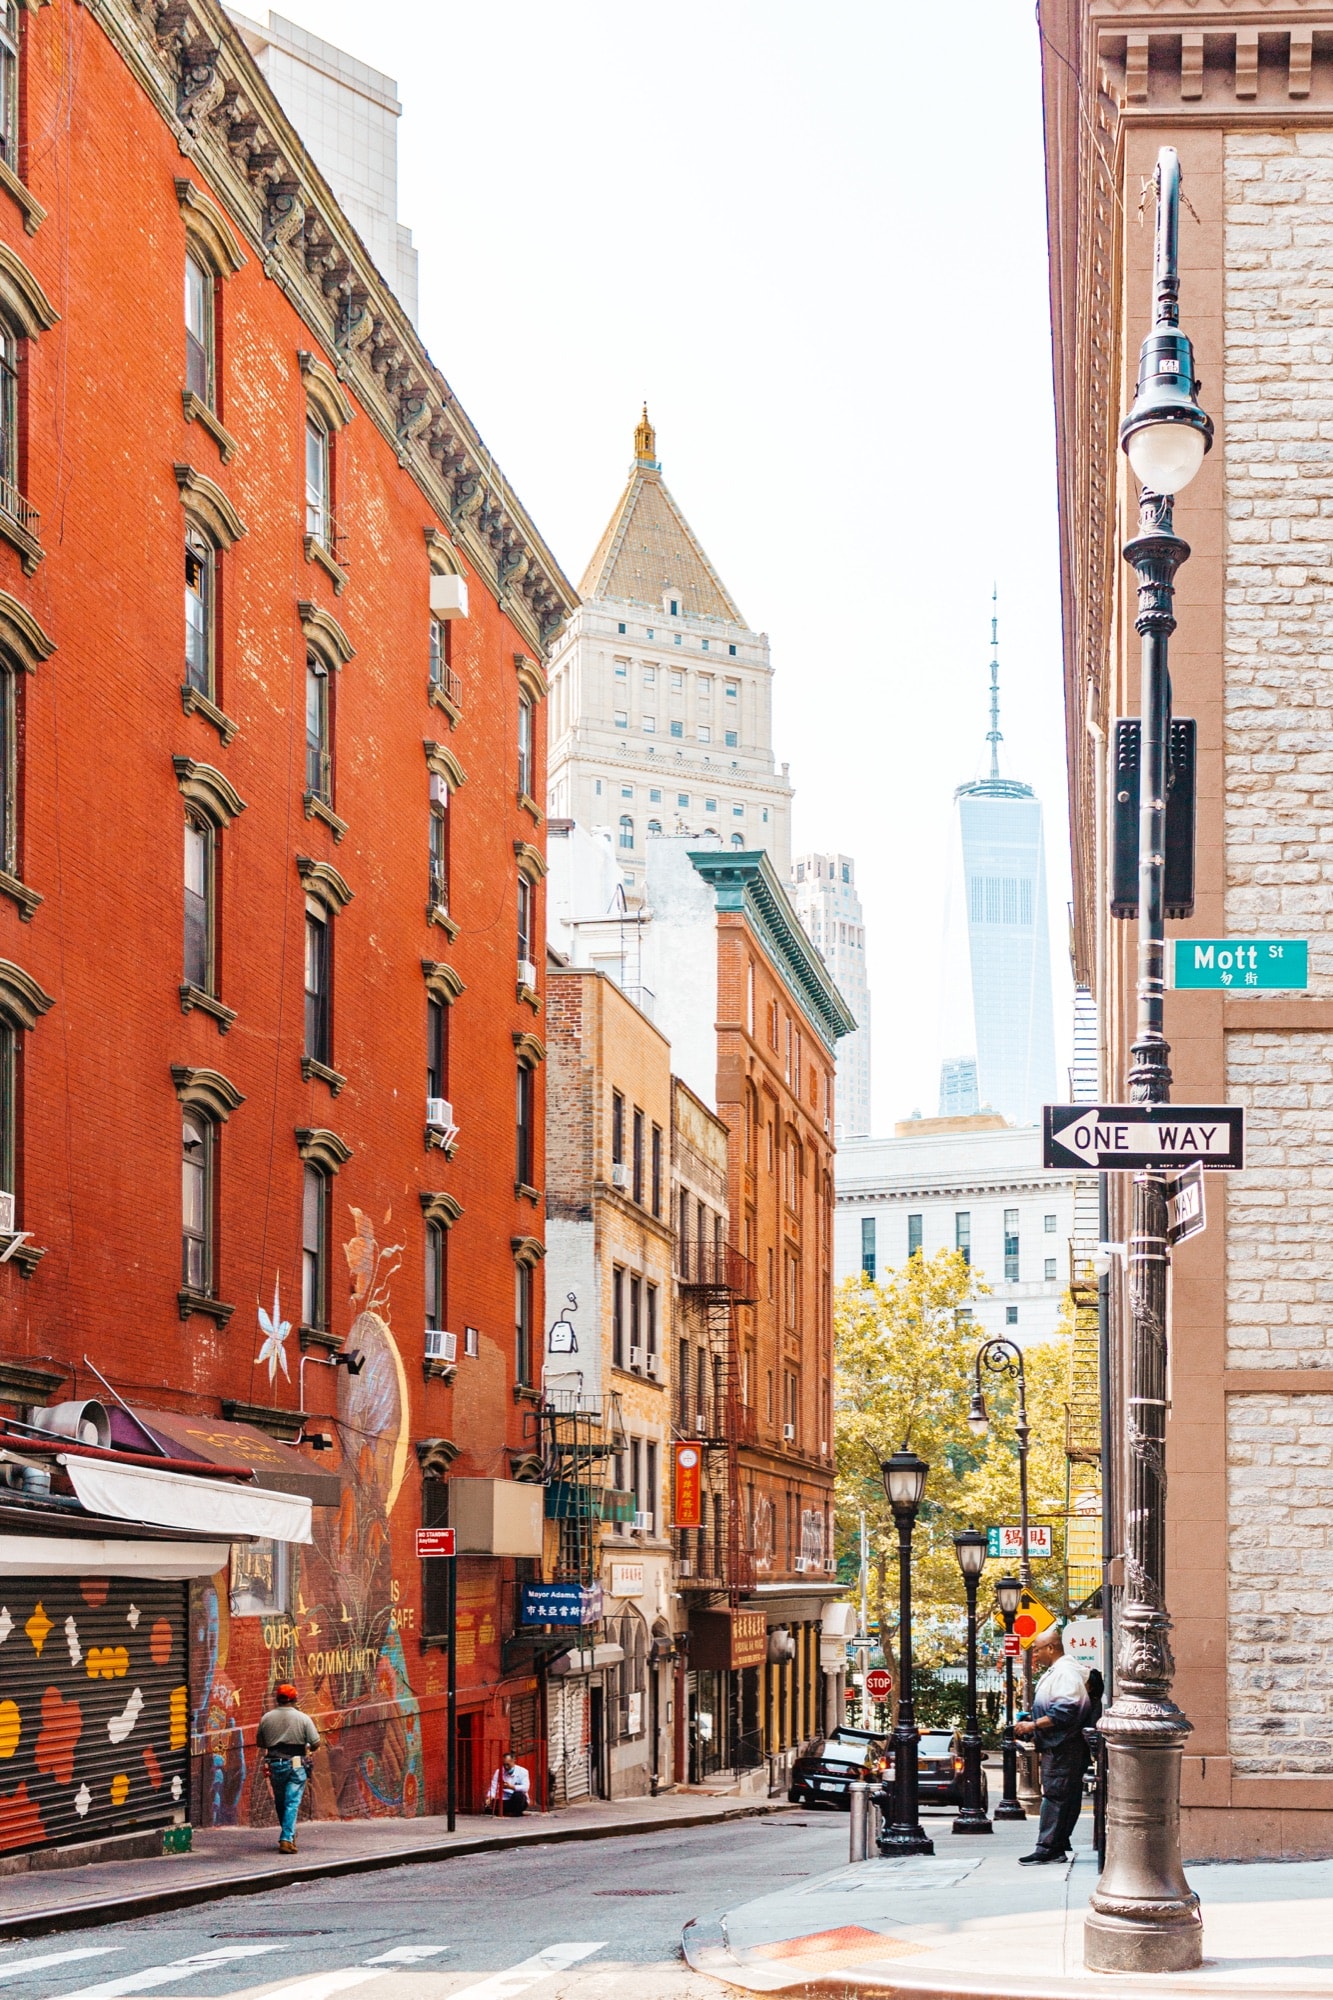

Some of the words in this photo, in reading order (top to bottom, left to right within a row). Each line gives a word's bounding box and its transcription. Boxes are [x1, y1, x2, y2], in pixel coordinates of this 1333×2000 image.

[1194, 945, 1258, 969] Mott
[1268, 945, 1284, 958] St
[1220, 971, 1258, 985] 勿街
[1074, 1126, 1129, 1150] ONE
[1158, 1127, 1217, 1150] WAY
[1173, 1187, 1194, 1221] WAY
[1004, 1529, 1047, 1546] 鍋貼
[390, 1580, 400, 1602] IS
[528, 1590, 550, 1599] Mayor
[550, 1591, 577, 1599] Adams,
[390, 1608, 415, 1630] SAFE
[264, 1624, 291, 1649] OUR
[270, 1655, 304, 1680] ASIAN
[307, 1648, 379, 1677] COMMUNITY
[867, 1677, 890, 1688] STOP
